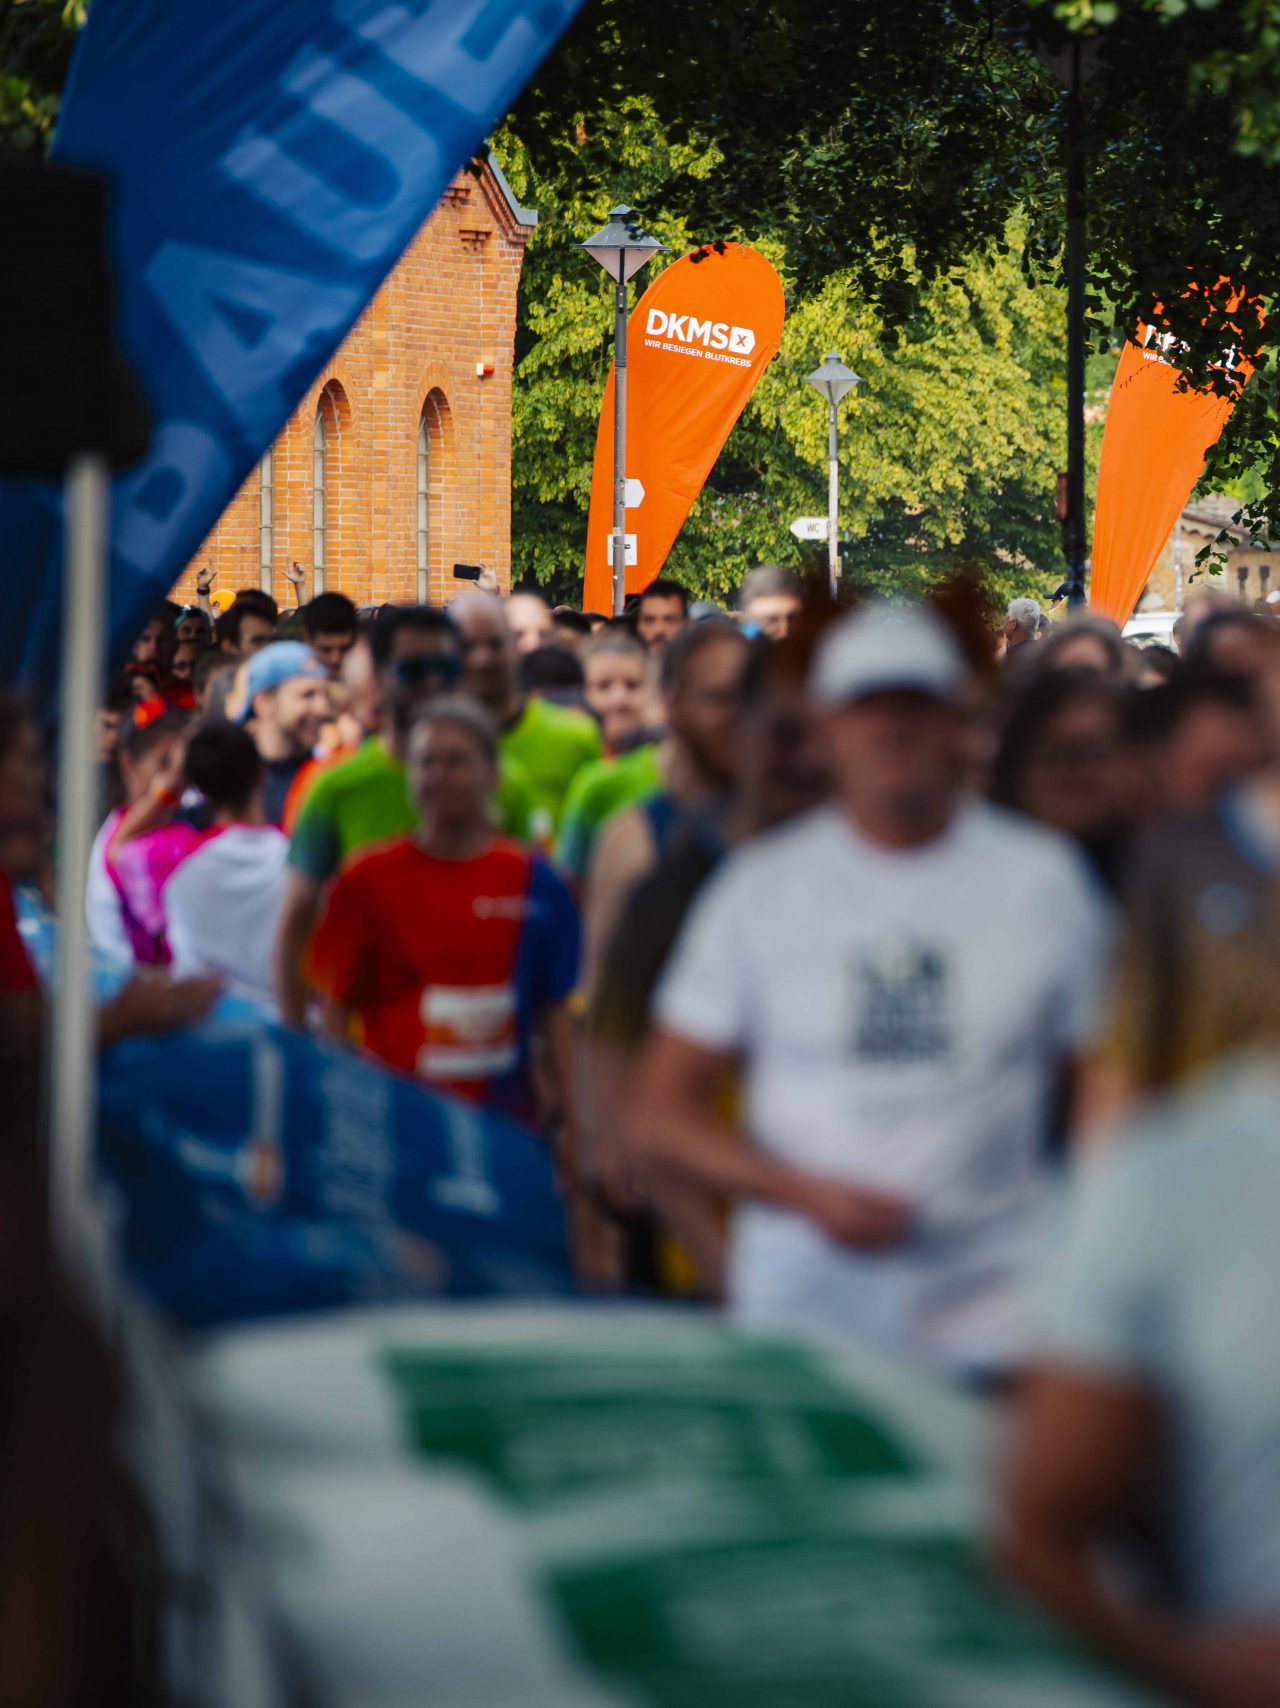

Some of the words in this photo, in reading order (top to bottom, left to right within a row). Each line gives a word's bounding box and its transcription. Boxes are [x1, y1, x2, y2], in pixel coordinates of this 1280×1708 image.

[646, 308, 729, 349] DKMS
[644, 338, 661, 349] WIR
[662, 342, 703, 358] BESIEGEN
[704, 351, 752, 368] BLUTKREBS
[1143, 352, 1157, 361] WIR
[807, 522, 820, 533] WC
